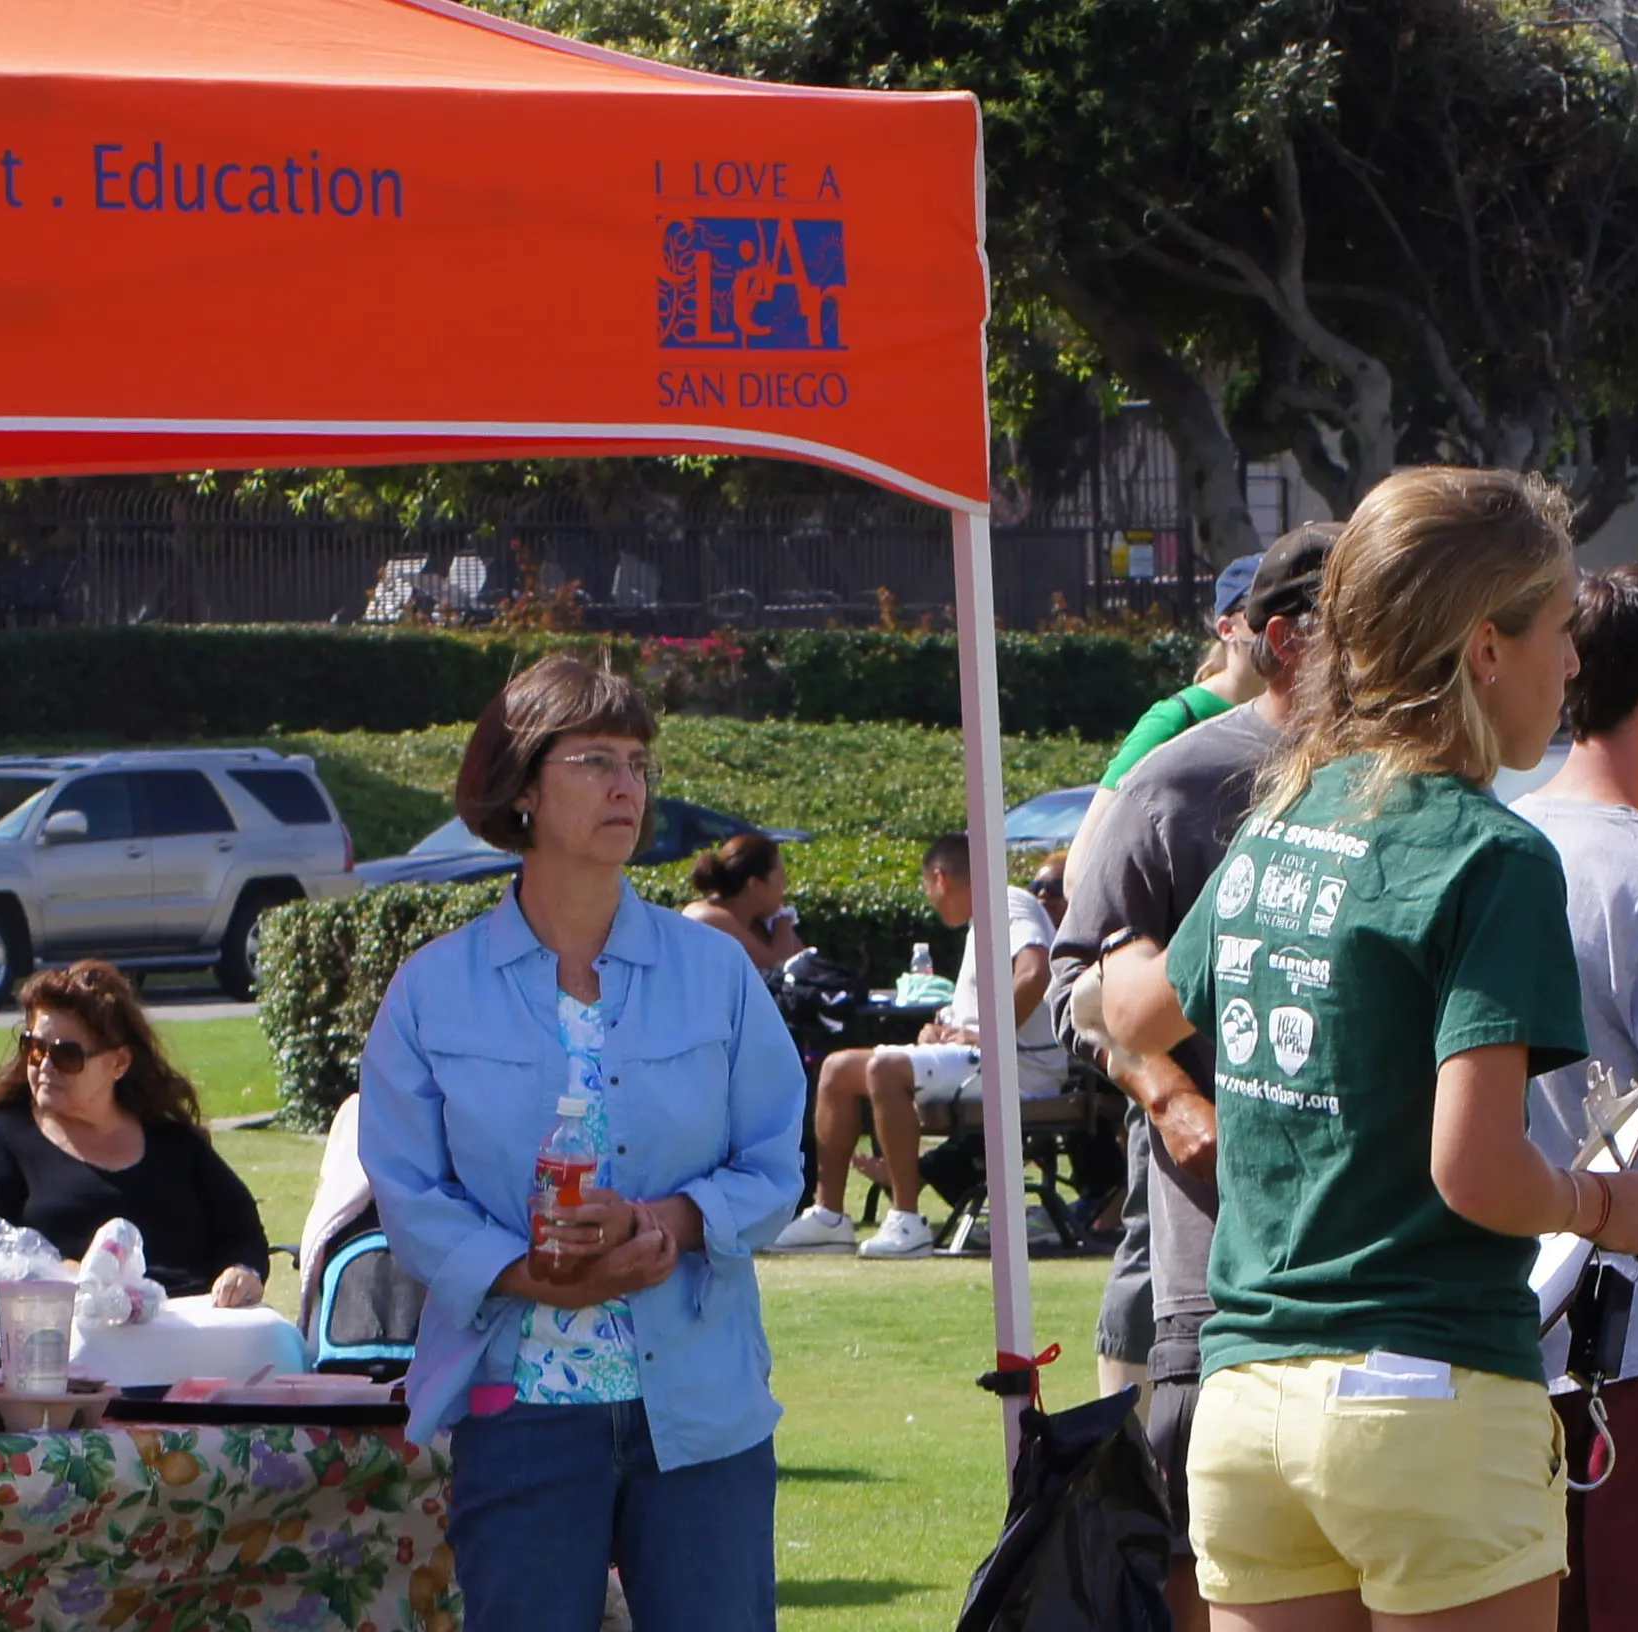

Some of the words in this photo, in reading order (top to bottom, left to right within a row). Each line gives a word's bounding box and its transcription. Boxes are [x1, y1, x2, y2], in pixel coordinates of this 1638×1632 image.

[92, 140, 404, 218] Education
[655, 159, 662, 195] I
[694, 161, 788, 198] LOVE
[818, 163, 841, 200] A
[657, 371, 726, 409] SAN
[738, 371, 850, 409] DIEGO
[1284, 824, 1370, 859] SPONSORS
[1280, 853, 1307, 869] LOVE
